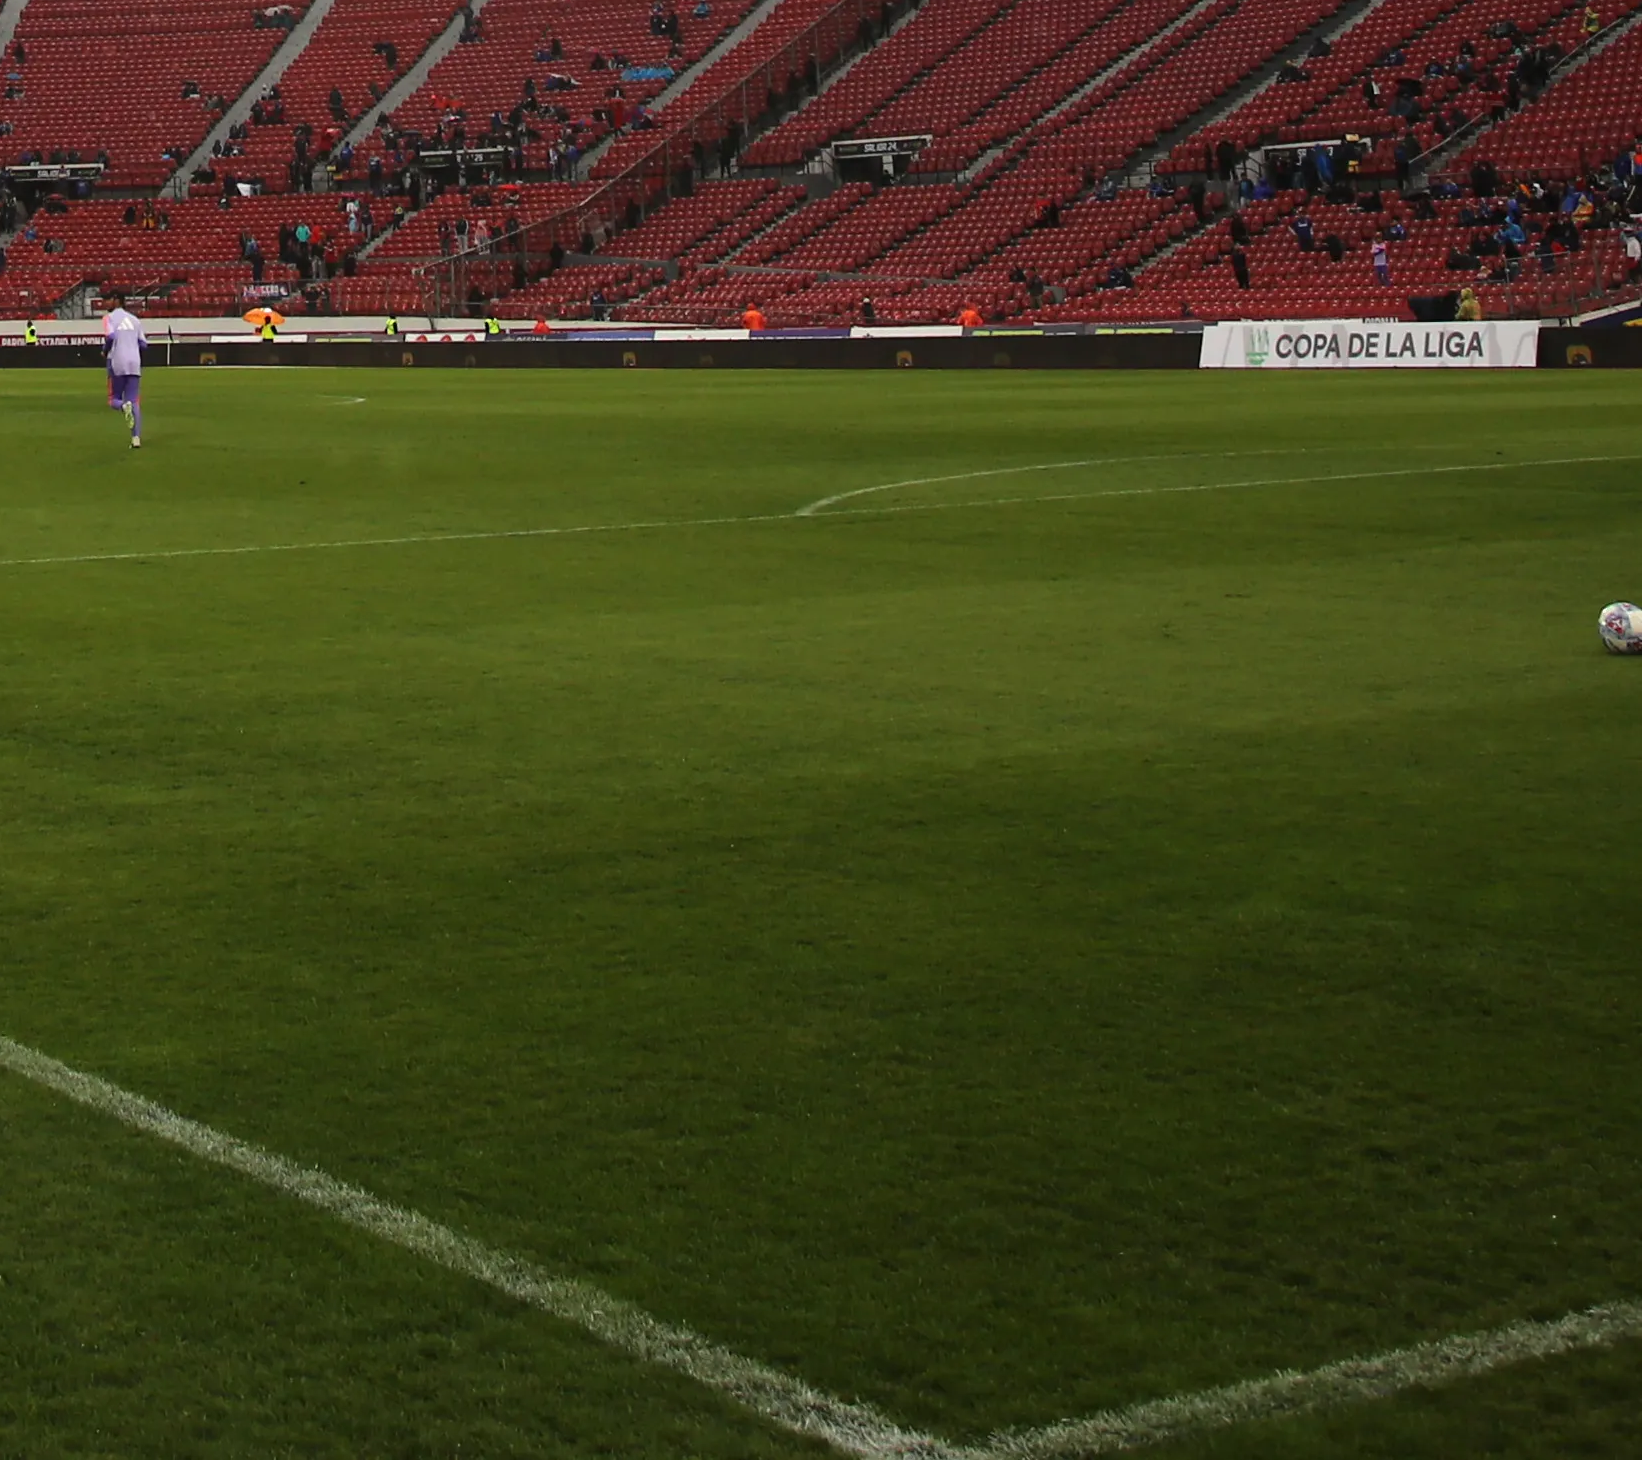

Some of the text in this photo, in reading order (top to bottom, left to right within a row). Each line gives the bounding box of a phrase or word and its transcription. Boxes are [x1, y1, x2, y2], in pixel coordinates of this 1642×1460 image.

[864, 142, 888, 152] SALIDA
[1275, 331, 1484, 359] COPA DE LA LIGA
